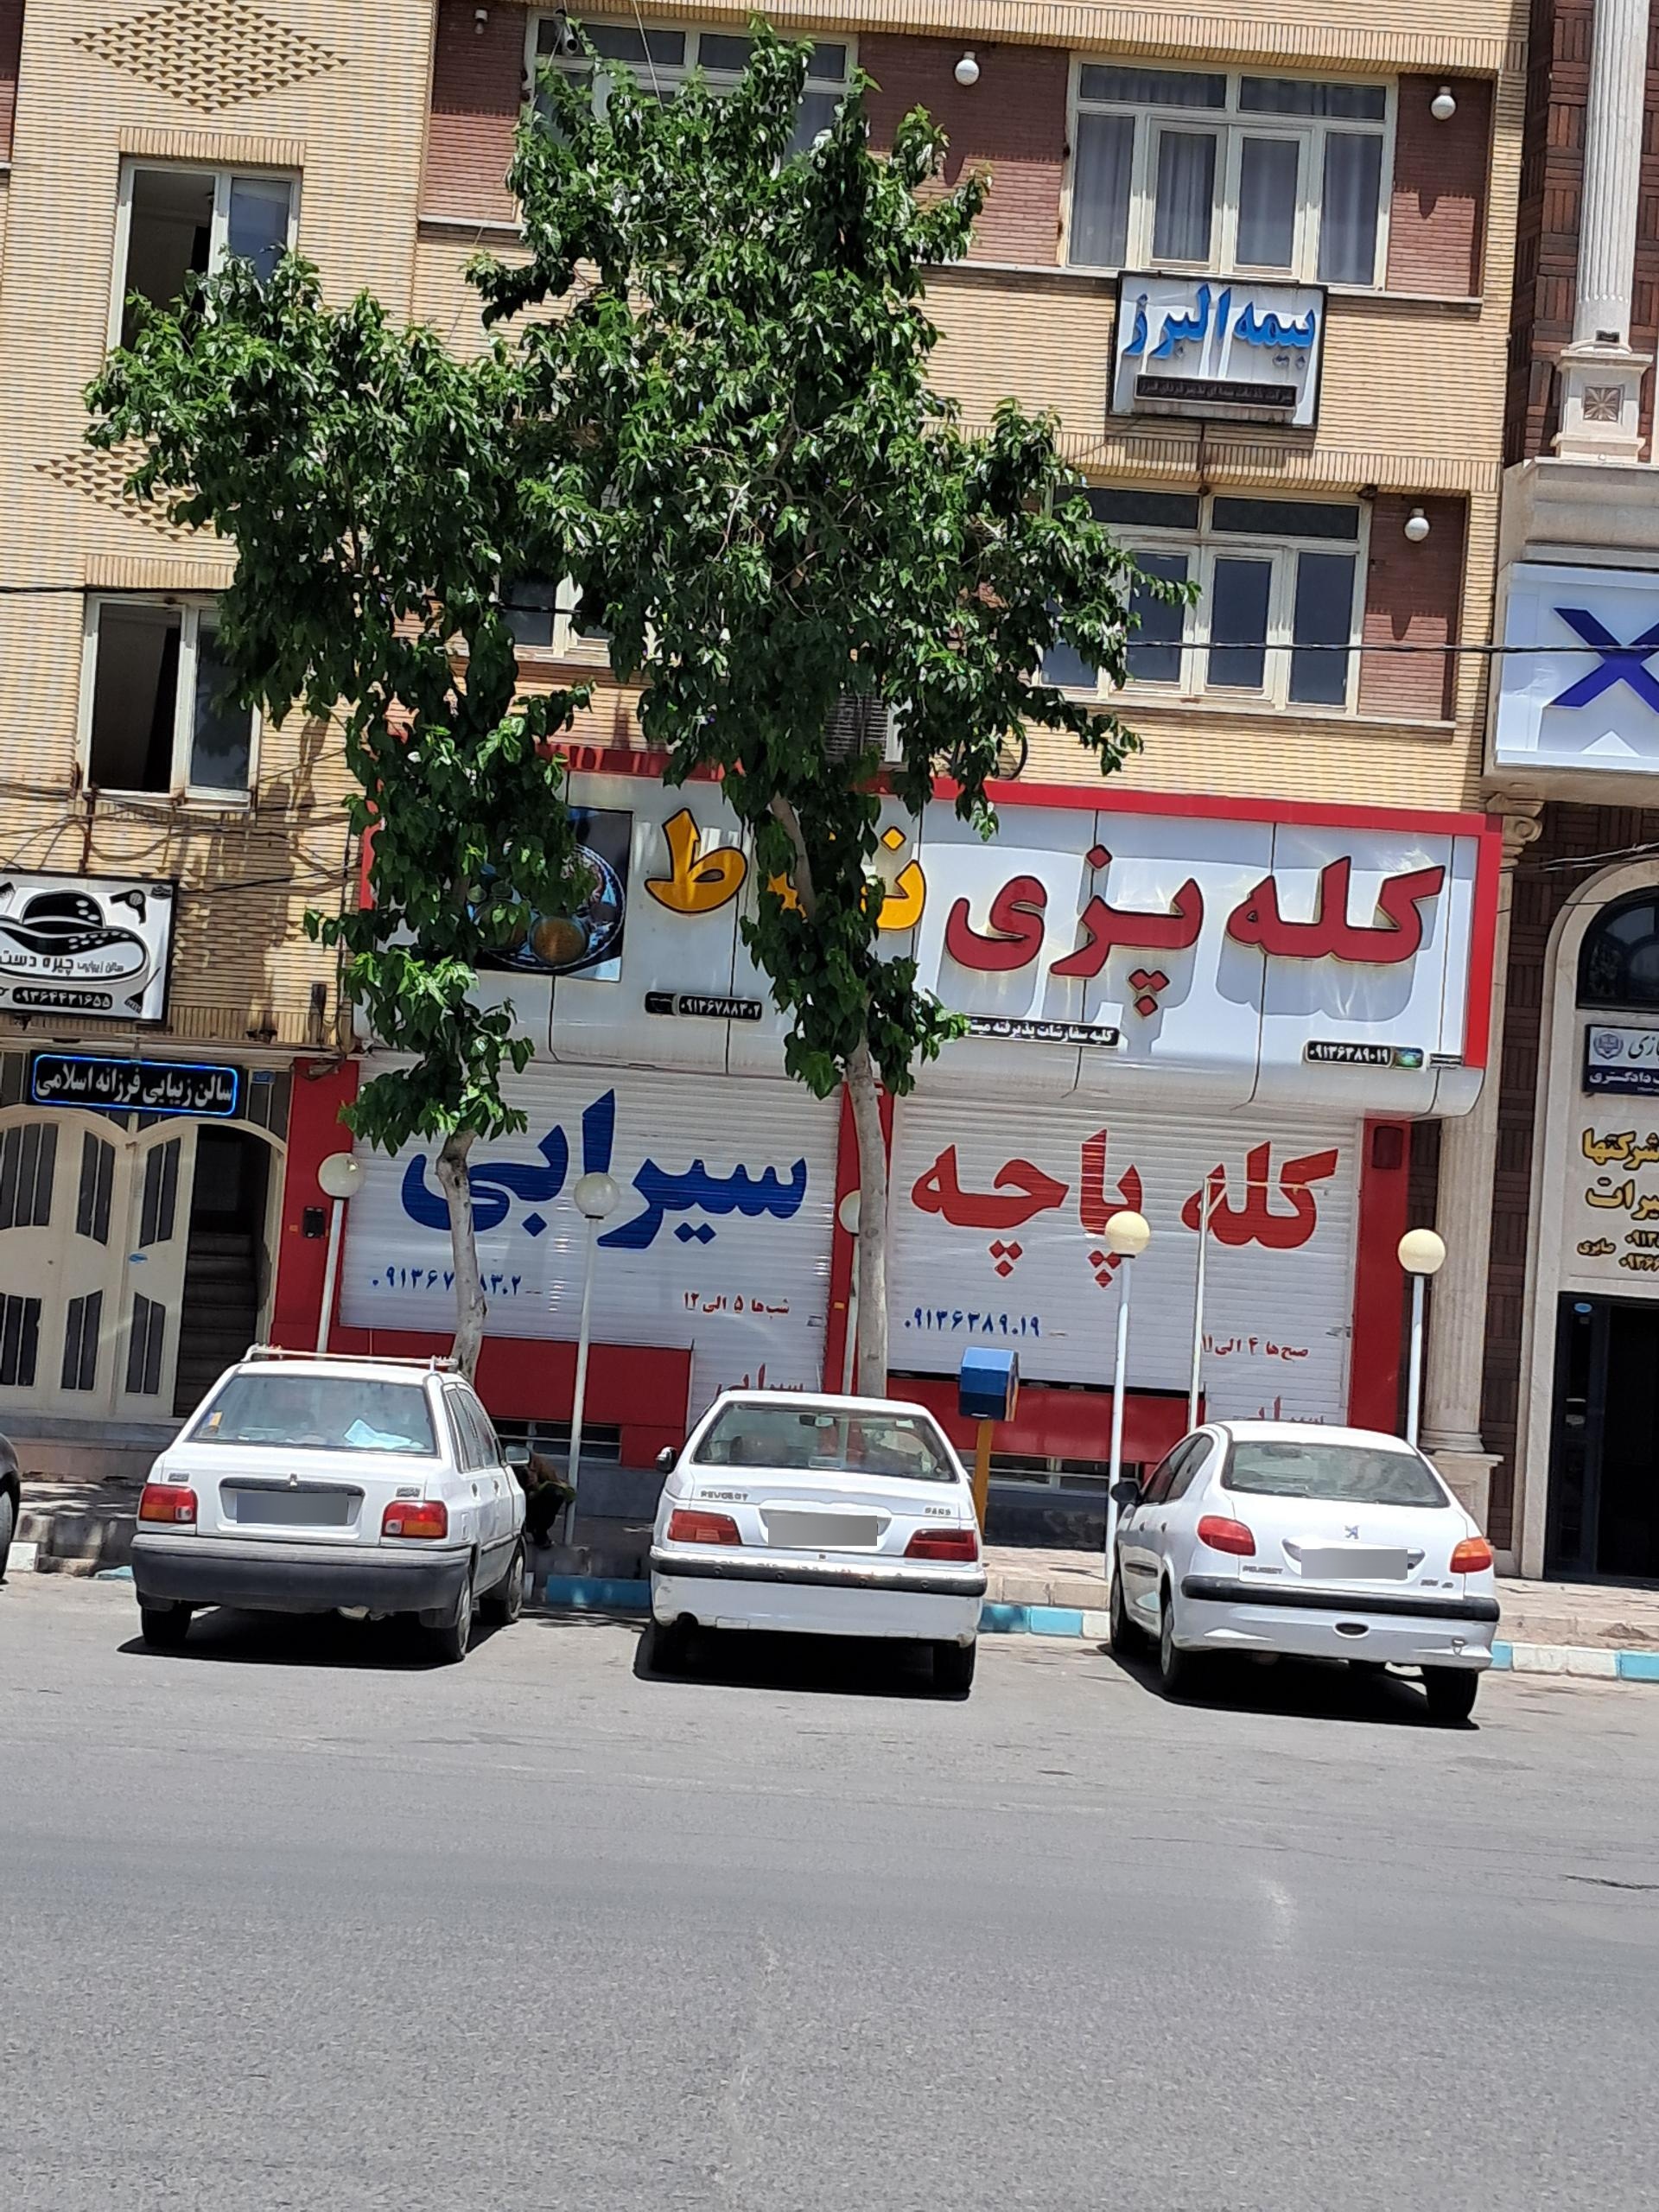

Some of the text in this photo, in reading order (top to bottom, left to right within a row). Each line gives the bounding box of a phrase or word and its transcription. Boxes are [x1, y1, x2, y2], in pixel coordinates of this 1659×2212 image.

[1124, 283, 1315, 370] بیمه البرز
[944, 843, 1205, 1018] پزی
[1226, 855, 1446, 964] کله
[35, 1064, 232, 1107] سالن زیبایی فرزانه اسلامی
[402, 1088, 807, 1249] سیرابی
[912, 1128, 1338, 1288] کله پاچه
[904, 1307, 1040, 1338] ۰۹۱۳۶۳۸۹۰۱۹
